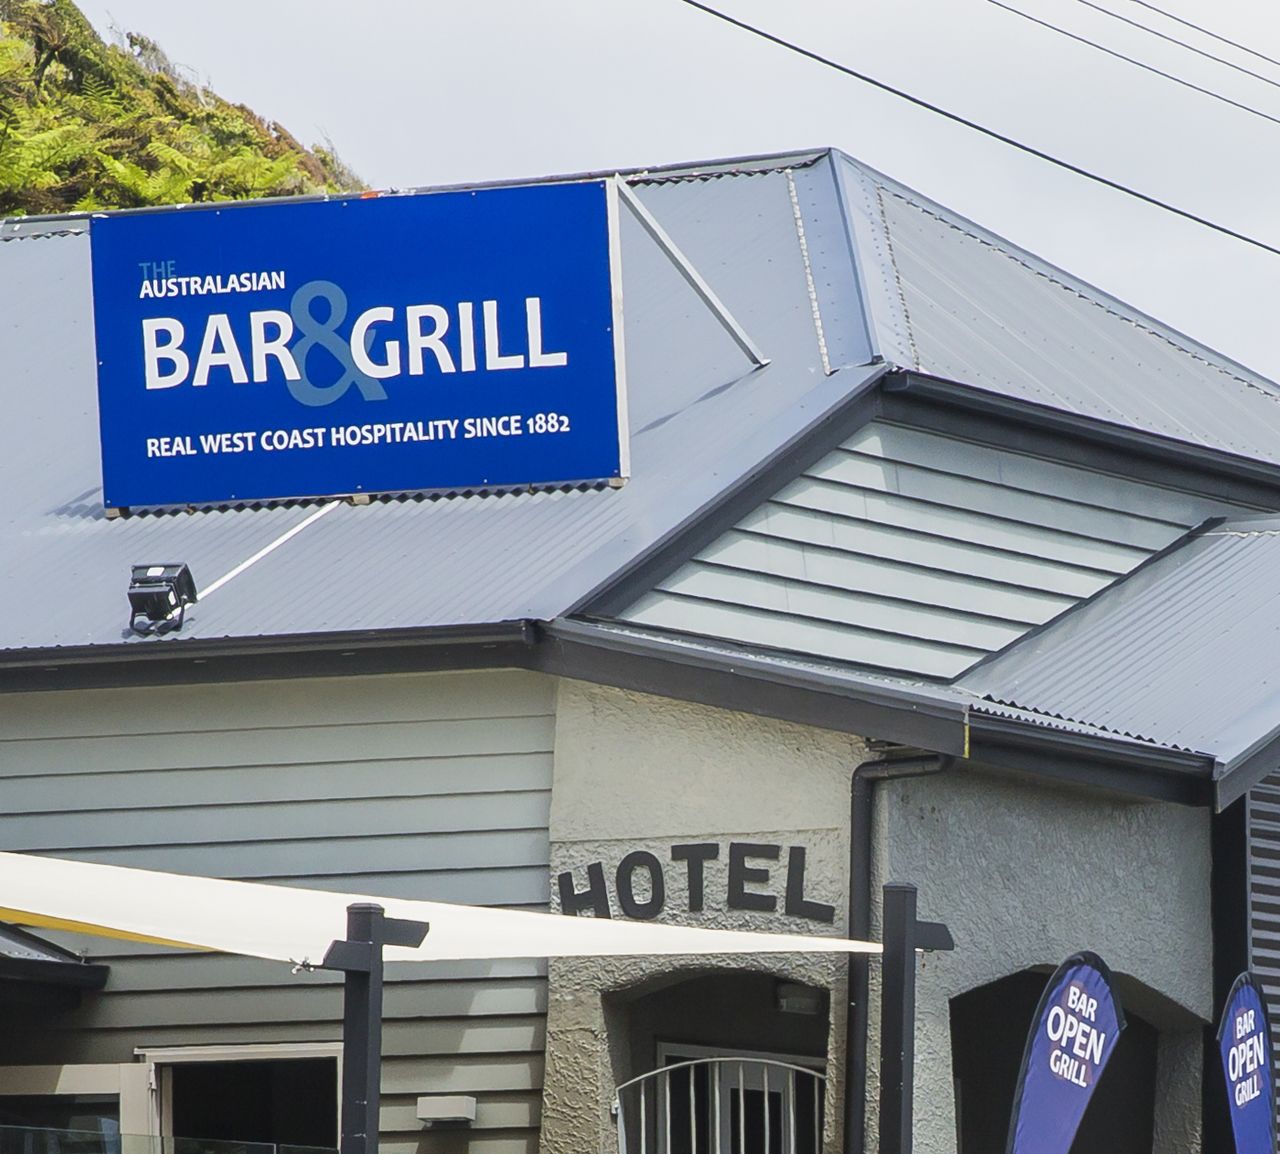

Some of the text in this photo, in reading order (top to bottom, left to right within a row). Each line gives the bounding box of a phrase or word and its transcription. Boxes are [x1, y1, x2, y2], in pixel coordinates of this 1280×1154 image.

[139, 271, 285, 298] AUSTRALASIAN
[140, 260, 176, 279] THE
[147, 413, 571, 457] REAL WEST COAST HOSPITALITY SINCE 1882
[558, 842, 835, 923] HOTEL
[1067, 986, 1097, 1022] BAR
[1046, 1006, 1105, 1064] OPEN
[1236, 1009, 1255, 1039] BAR
[1049, 1049, 1088, 1087] GRILL
[1229, 1032, 1264, 1081] OPEN
[1235, 1074, 1260, 1106] GRILL
